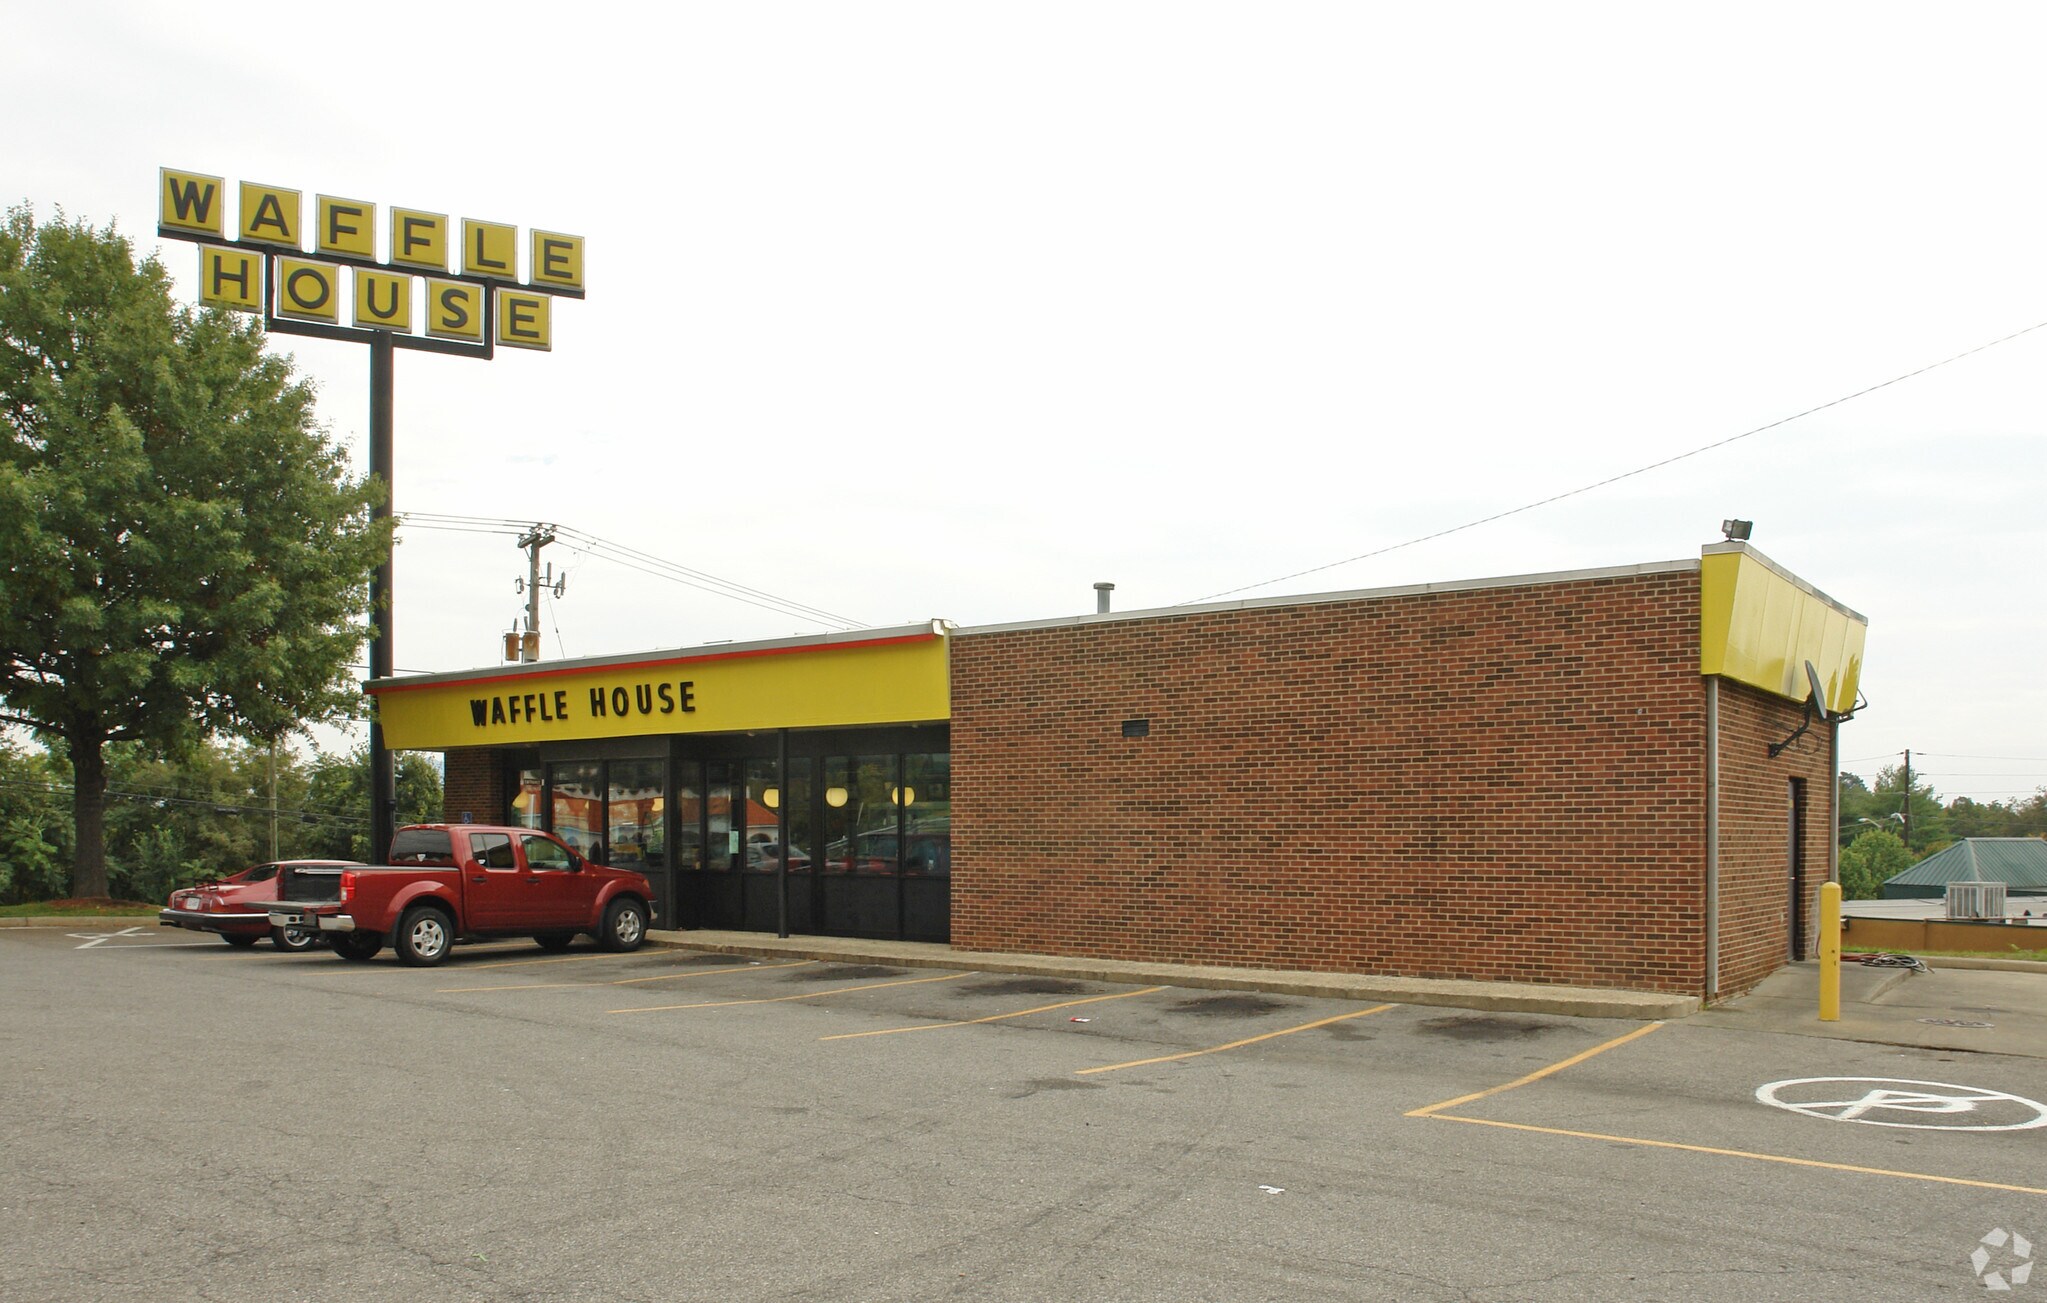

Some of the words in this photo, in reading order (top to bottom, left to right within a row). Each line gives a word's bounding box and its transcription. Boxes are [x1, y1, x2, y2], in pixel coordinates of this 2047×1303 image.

[169, 177, 574, 279] WAFFLE
[214, 255, 540, 338] HOUSE
[470, 690, 568, 726] WAFFLE
[589, 681, 696, 717] HOUSE
